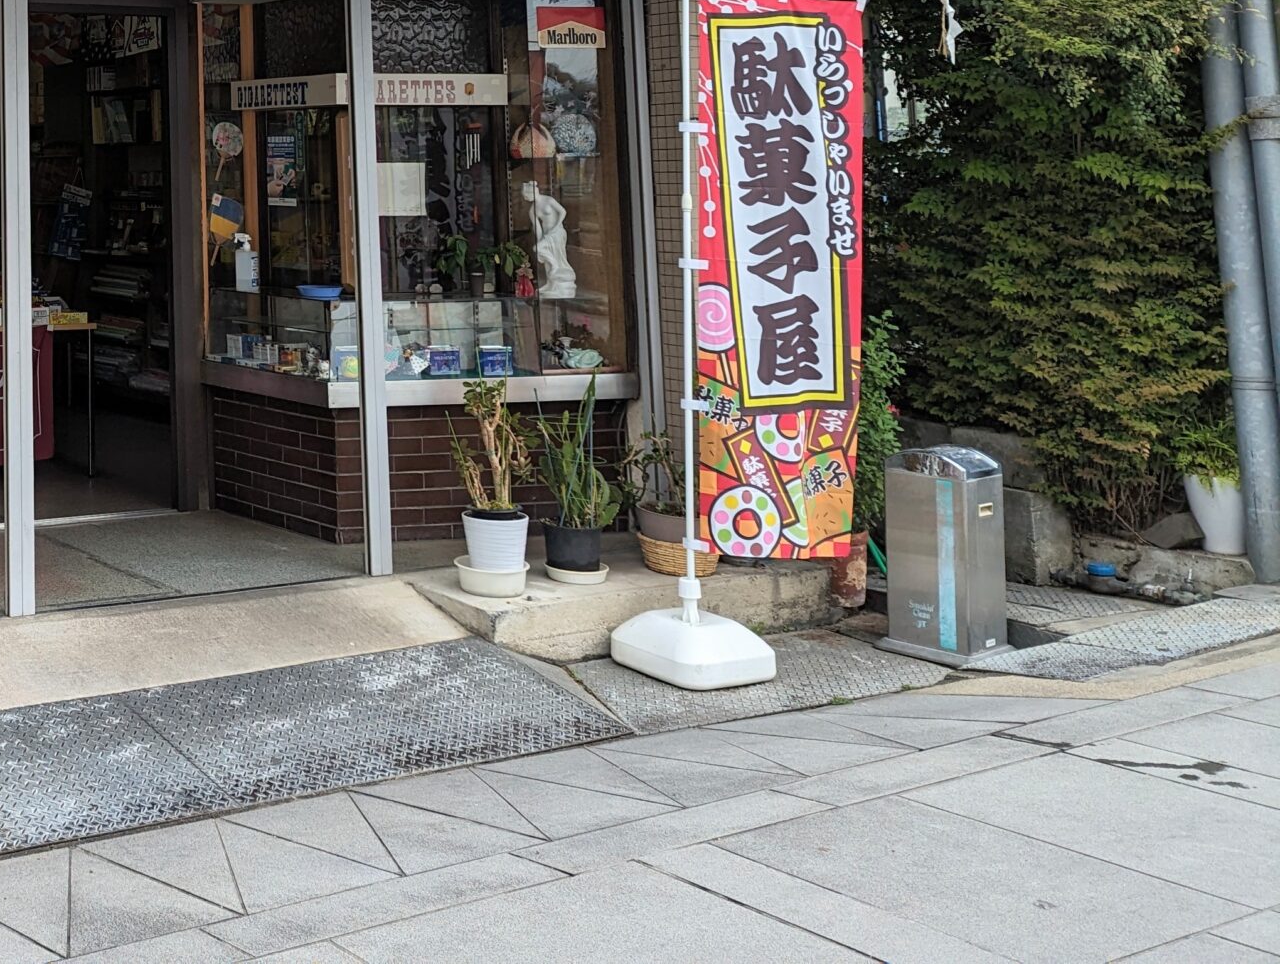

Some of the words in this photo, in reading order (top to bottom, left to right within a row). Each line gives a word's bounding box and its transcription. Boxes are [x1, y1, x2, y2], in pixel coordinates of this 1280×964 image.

[546, 27, 597, 45] Marlboro
[816, 23, 855, 257] いらっしゃいませ
[730, 32, 824, 388] 駄菓子屋
[742, 455, 777, 499] 駄菓
